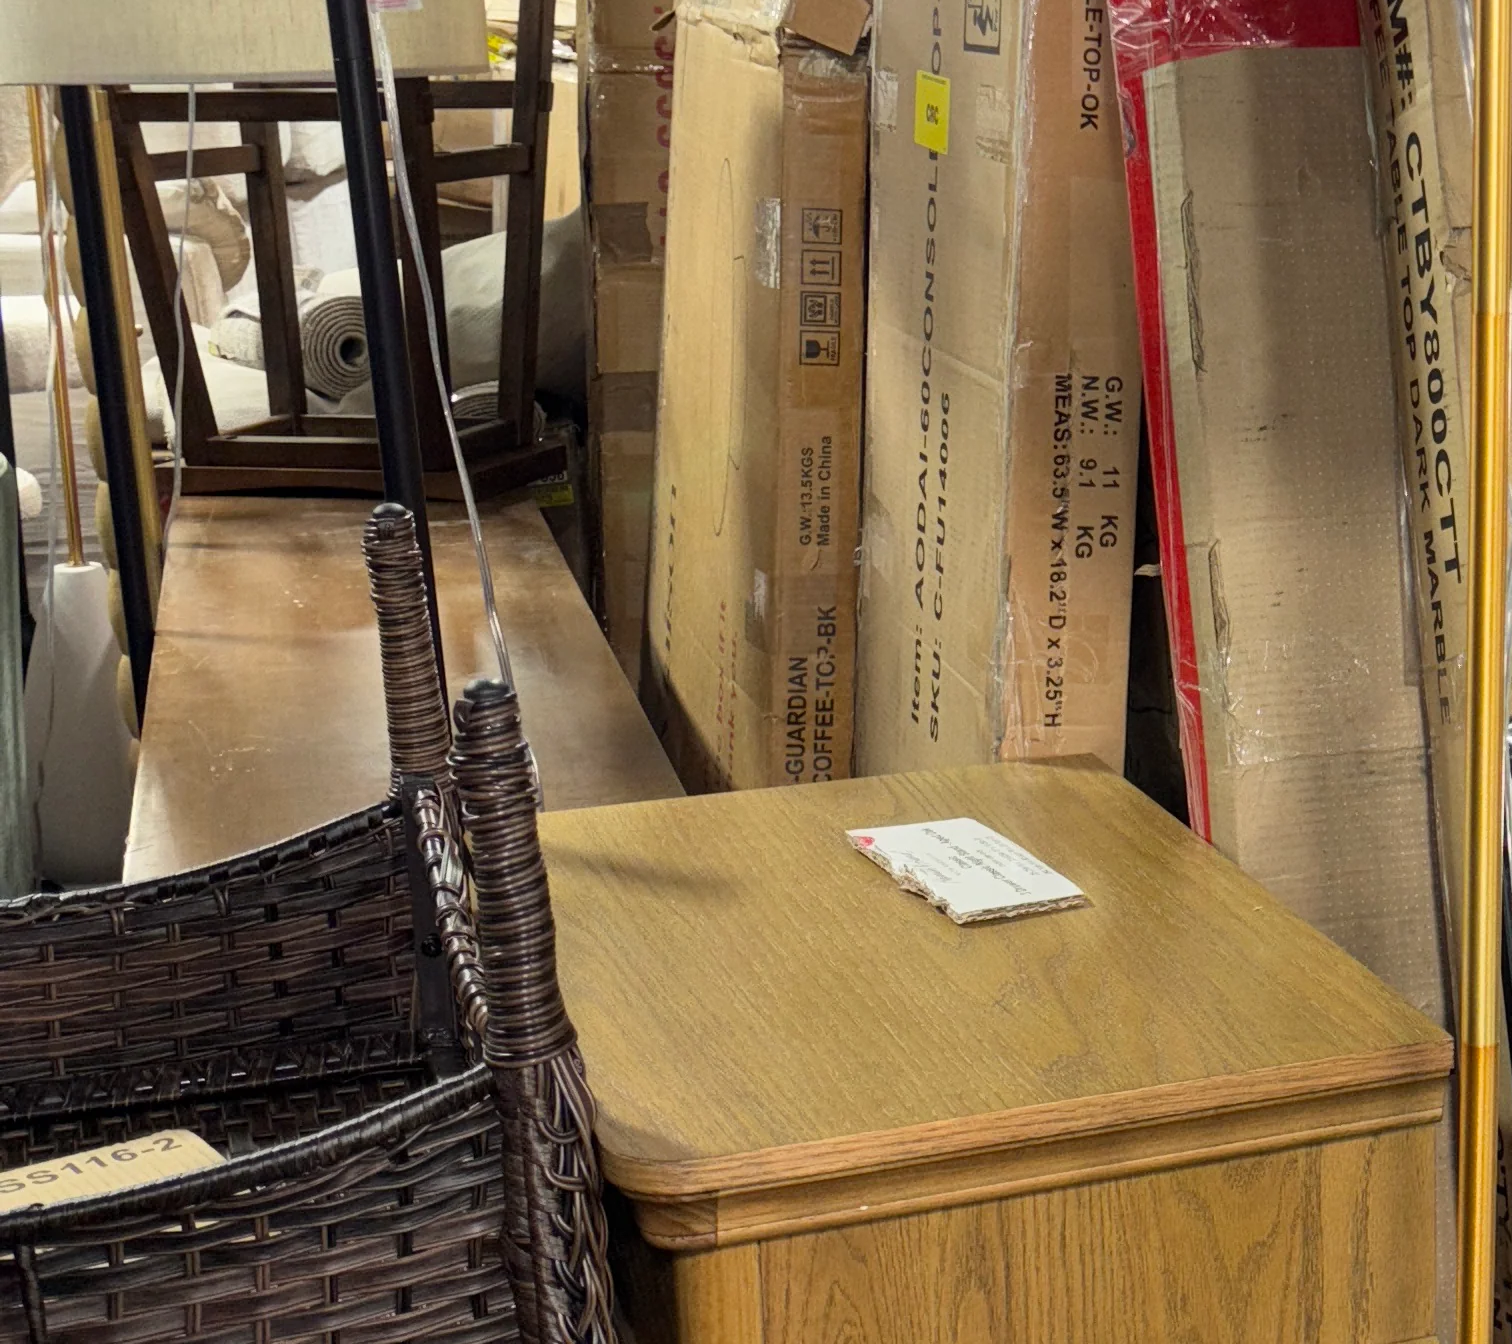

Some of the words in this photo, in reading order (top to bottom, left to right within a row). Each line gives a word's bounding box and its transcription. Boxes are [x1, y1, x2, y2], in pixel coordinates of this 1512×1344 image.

[1386, 98, 1410, 256] TABLE
[1401, 264, 1417, 361] TOP
[1405, 130, 1462, 584] CTBY800CTT
[1080, 375, 1101, 435] N.W.:
[1104, 375, 1124, 436] G.W.:
[815, 435, 832, 482] China
[1078, 457, 1098, 489] 9.1
[1408, 377, 1431, 514] DARK
[817, 487, 831, 501] in
[932, 391, 950, 621] C-FU14006
[1102, 466, 1120, 489] 11
[816, 506, 832, 547] Made
[1050, 537, 1062, 552] x
[1075, 524, 1095, 560] KG
[1099, 513, 1119, 549] KG
[1046, 637, 1061, 650] x
[1423, 529, 1452, 726] MARBLE
[911, 622, 923, 725] Item:
[929, 637, 942, 744] SKU:
